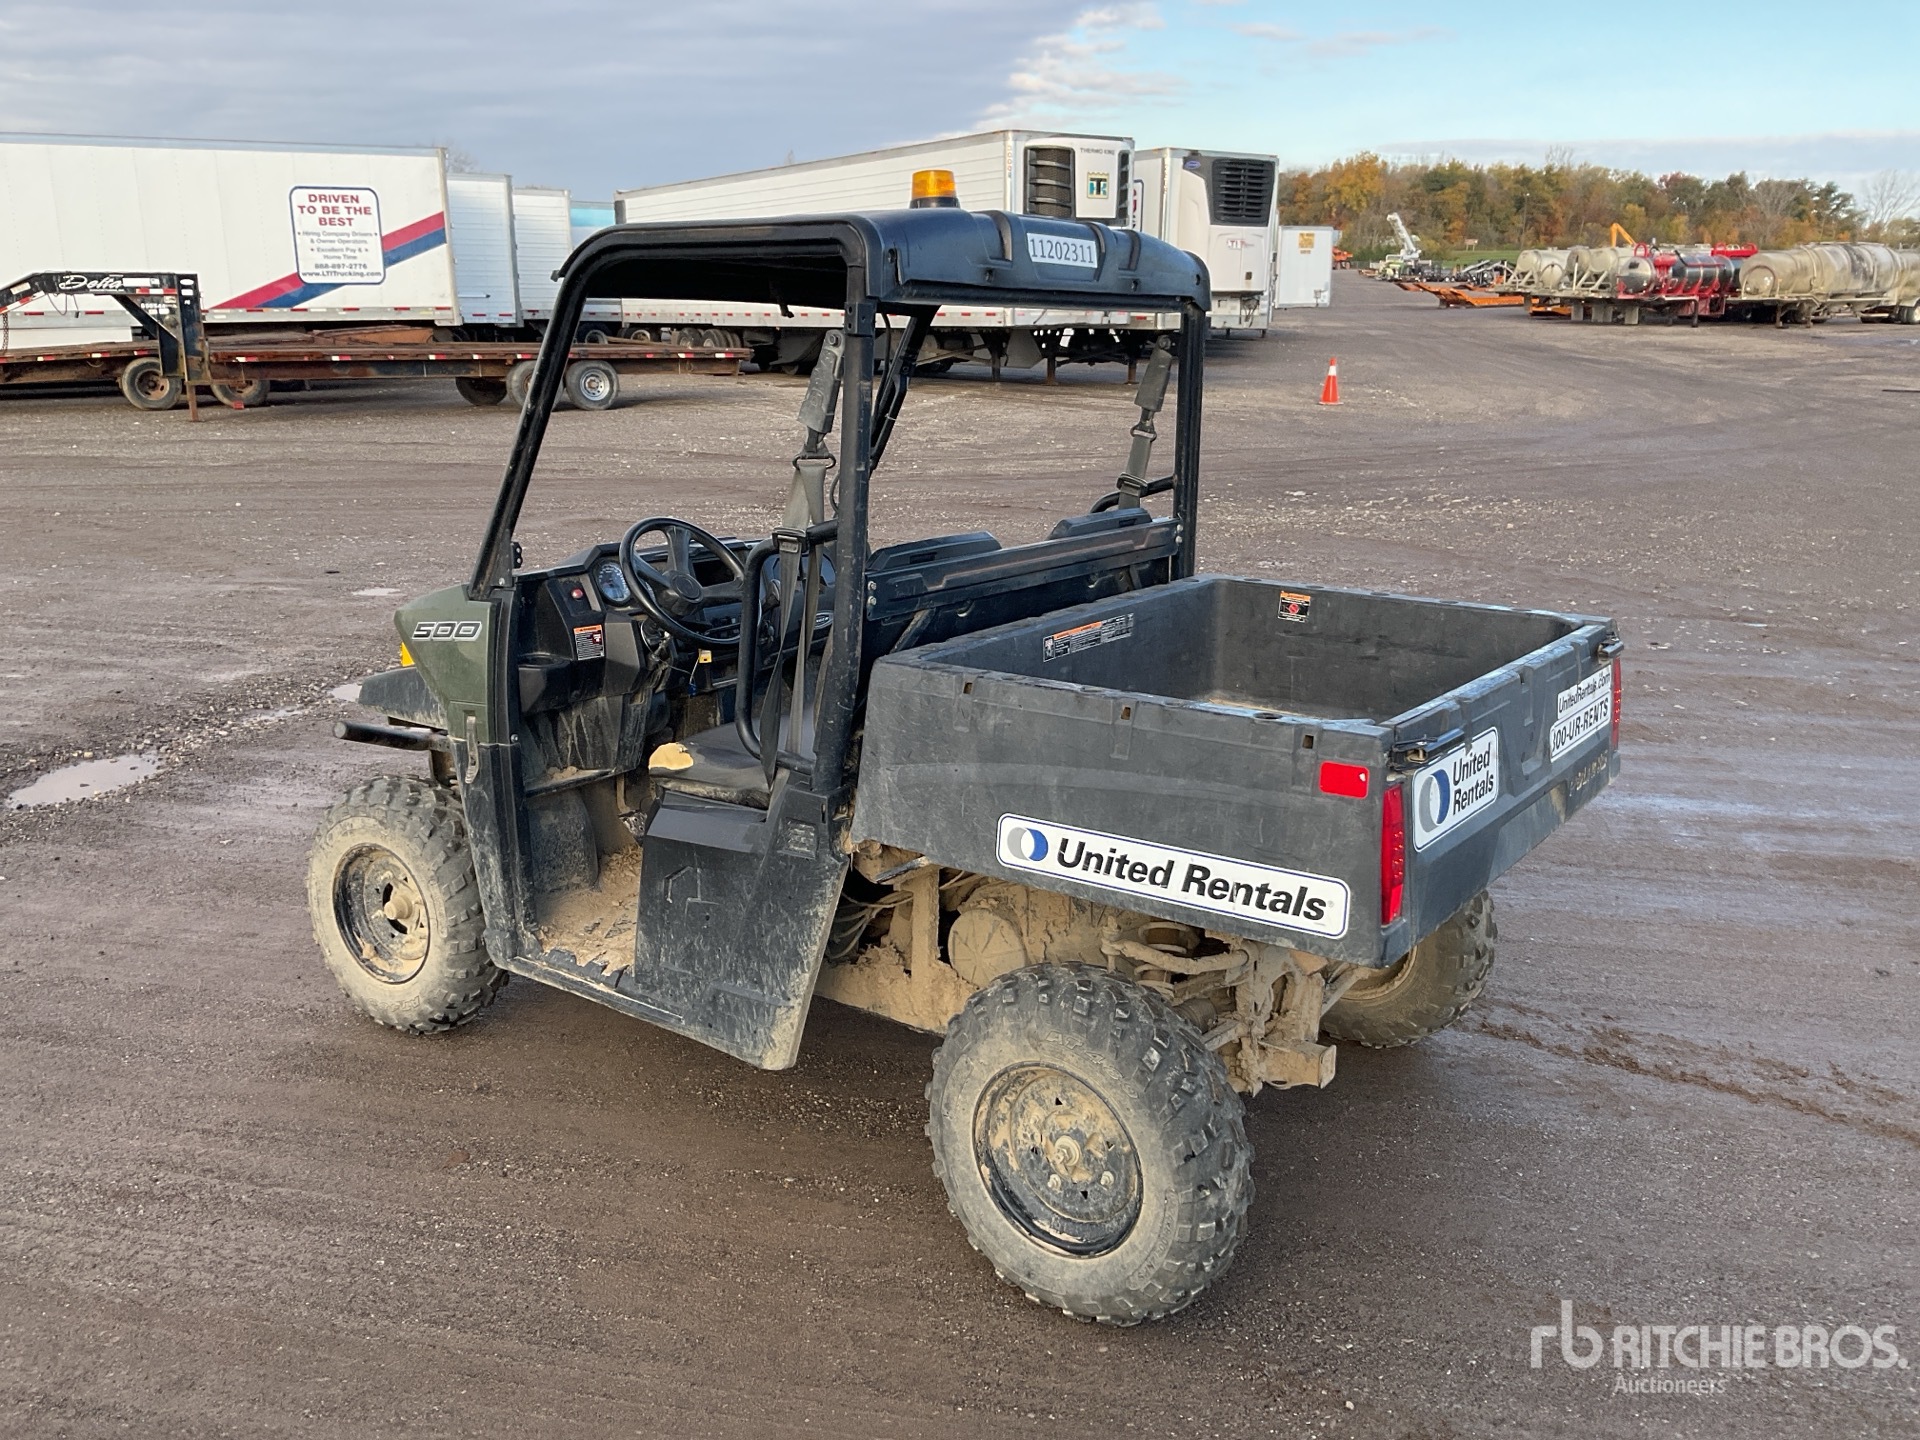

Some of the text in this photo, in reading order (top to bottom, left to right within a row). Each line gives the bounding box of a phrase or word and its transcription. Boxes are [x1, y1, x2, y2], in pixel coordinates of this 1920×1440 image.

[308, 193, 360, 204] DRIVEN
[297, 205, 373, 216] TO BE THE
[318, 217, 354, 227] BEST
[322, 230, 350, 238] Company
[1030, 238, 1094, 264] 11202311
[58, 274, 124, 290] Delta
[301, 270, 382, 278] www.LTITrucking.com
[412, 620, 483, 641] 500
[1559, 672, 1611, 714] UnitedRentals.com
[1452, 742, 1491, 786] United
[1453, 771, 1494, 816] Rentals
[1057, 837, 1328, 921] United Rentals
